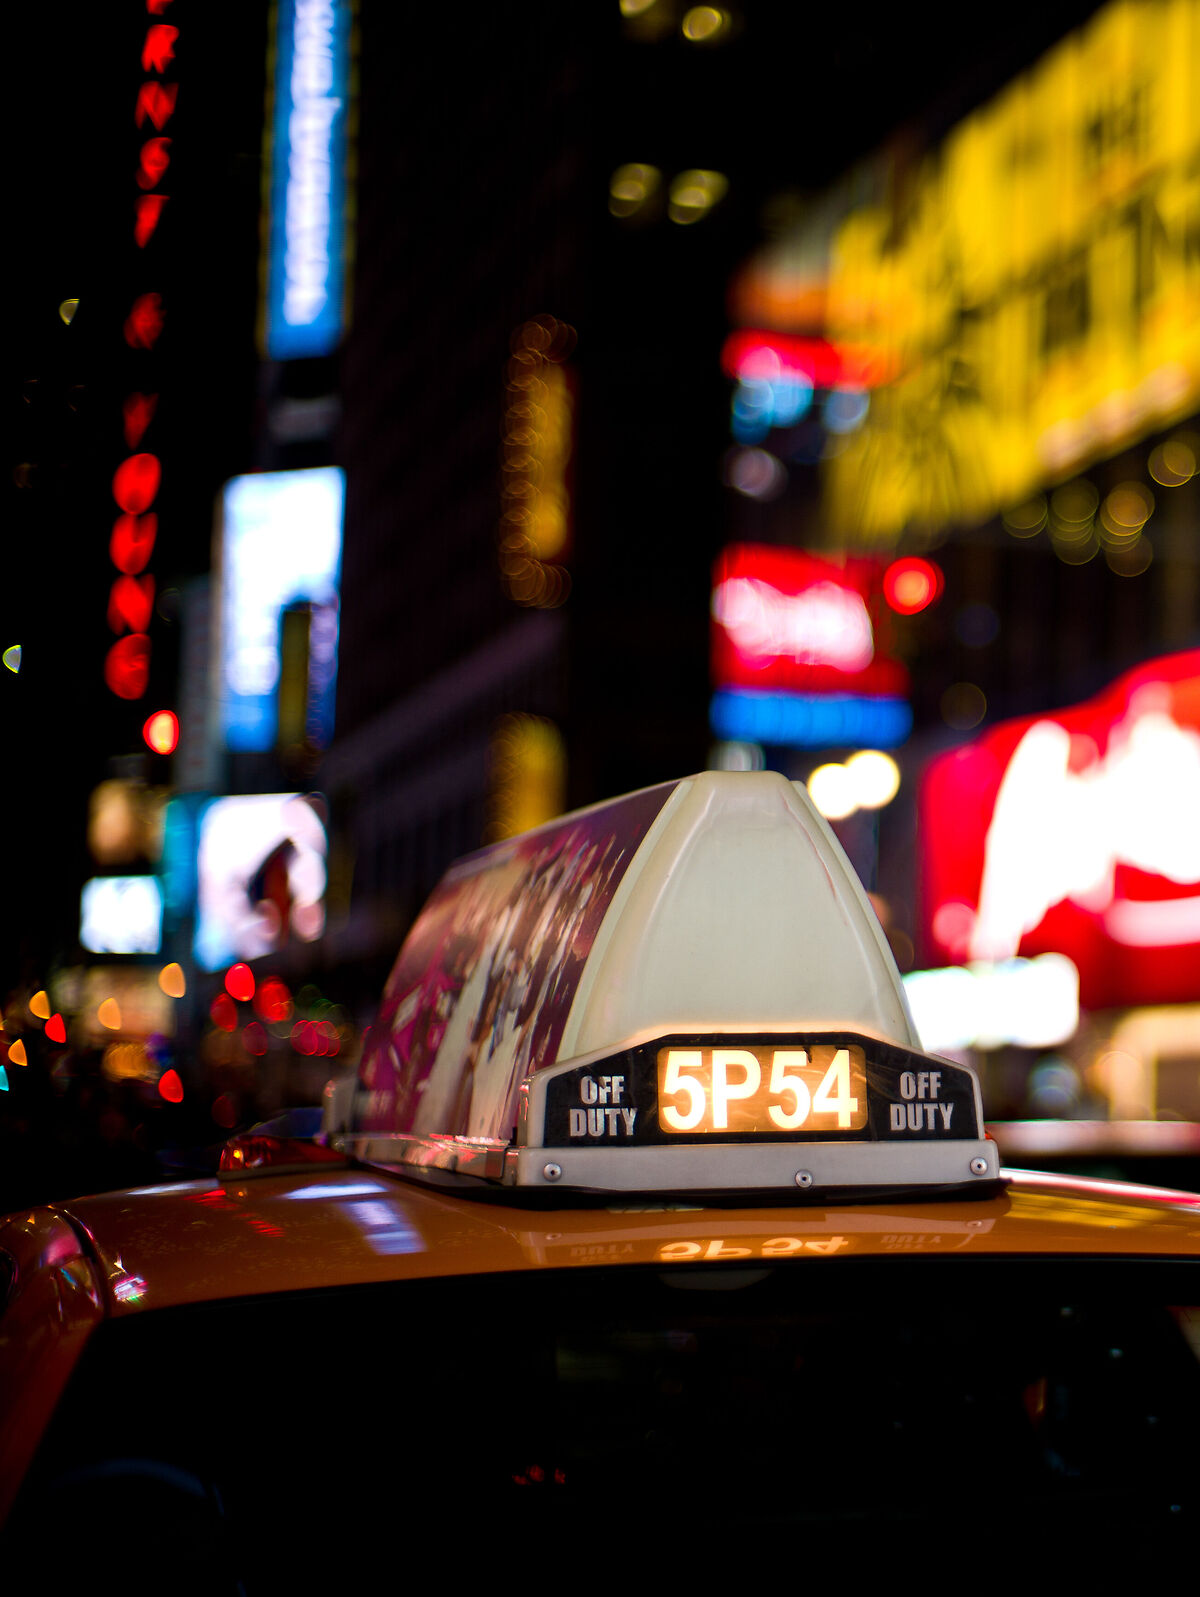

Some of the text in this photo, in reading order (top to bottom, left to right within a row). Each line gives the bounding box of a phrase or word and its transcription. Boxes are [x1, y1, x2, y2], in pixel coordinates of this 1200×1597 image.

[580, 1075, 625, 1105] OFF
[662, 1049, 859, 1130] 5P54
[900, 1071, 941, 1100] OFF
[569, 1107, 638, 1137] DUTY
[889, 1102, 954, 1132] DUTY
